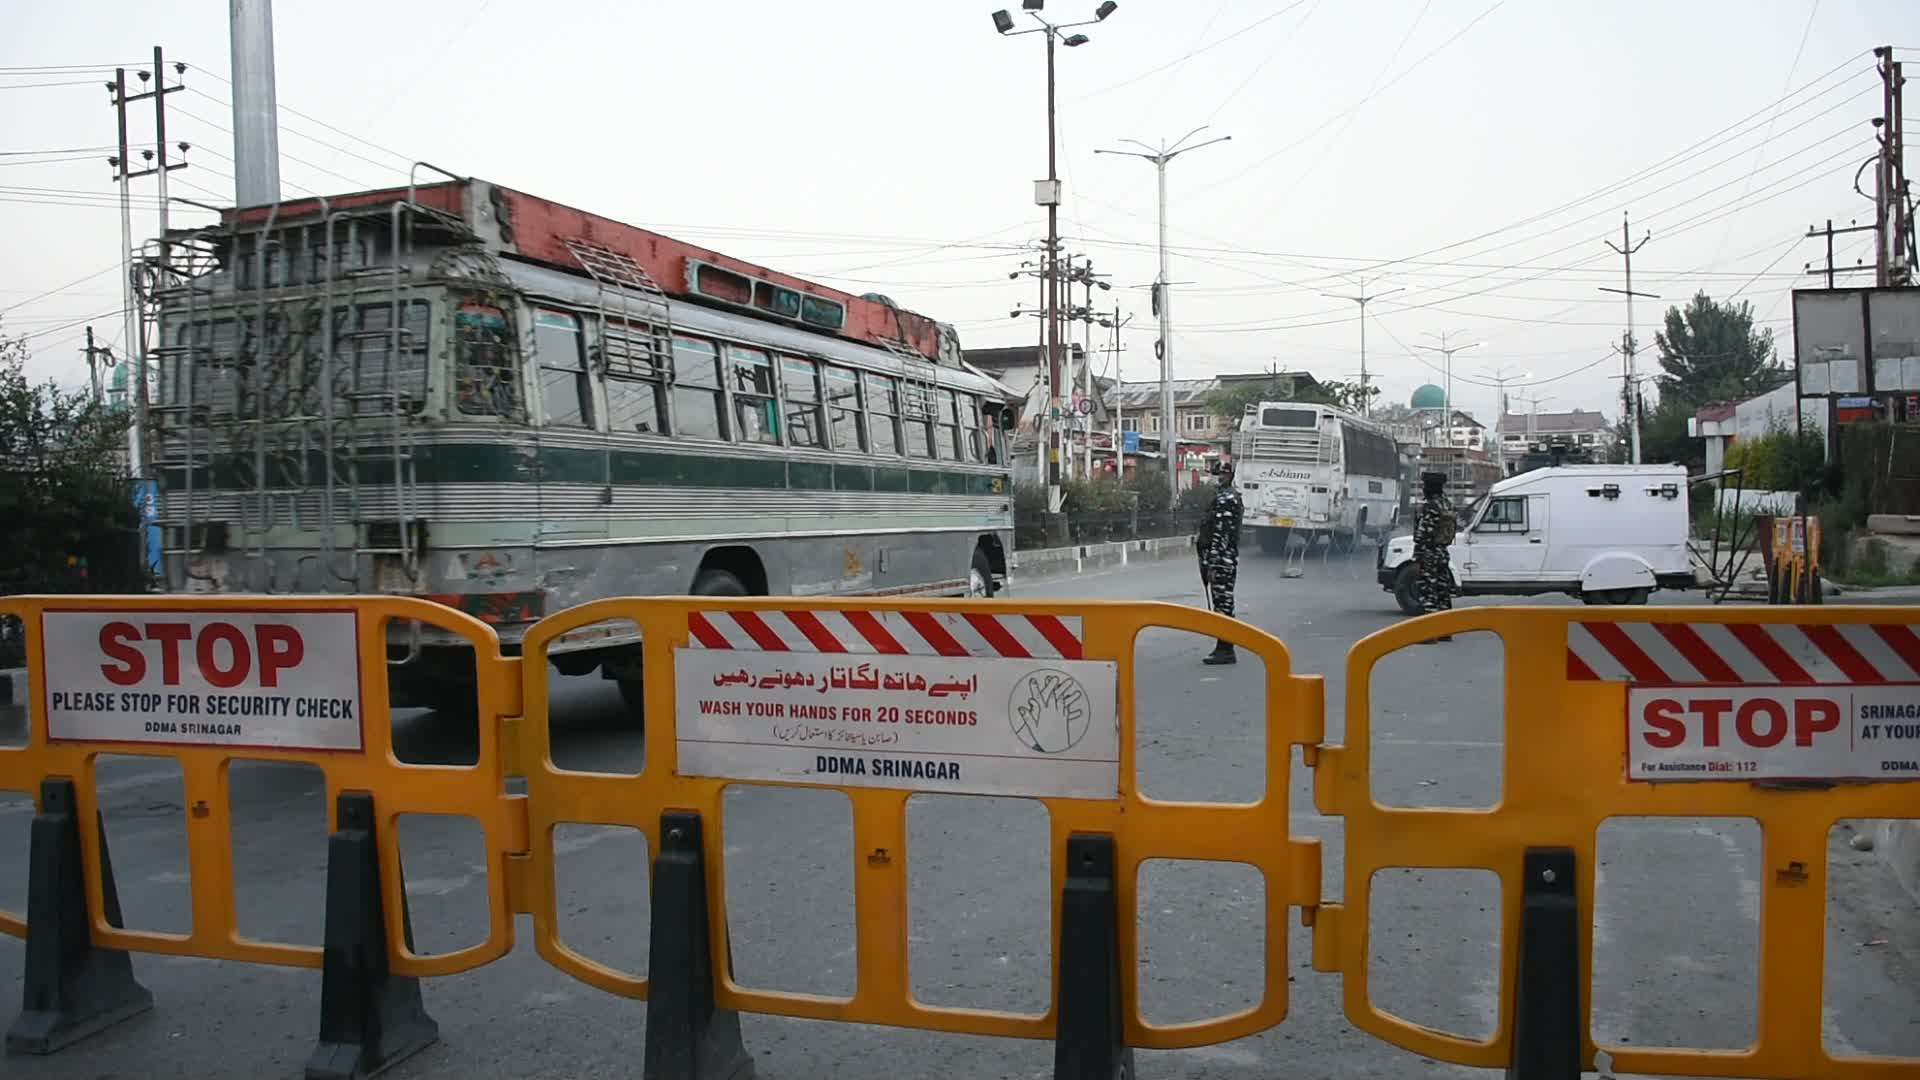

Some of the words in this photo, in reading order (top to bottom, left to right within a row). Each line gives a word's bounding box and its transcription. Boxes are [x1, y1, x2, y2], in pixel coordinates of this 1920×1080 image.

[100, 622, 304, 688] STOP
[52, 692, 115, 712] PLEASE
[121, 693, 162, 713] STOP
[167, 695, 200, 715] FOR
[206, 695, 291, 718] SECURITY
[295, 697, 353, 720] CHECK
[699, 701, 742, 716] WASH
[746, 702, 785, 718] YOUR
[789, 704, 838, 721] HANDS
[842, 707, 872, 723] FOR
[877, 706, 900, 723] 20
[905, 708, 978, 726] SECONDS
[144, 720, 178, 734] DDMA
[180, 722, 242, 736] SRINAGAR
[1643, 698, 1841, 748] STOP
[1861, 725, 1881, 739] AT
[816, 755, 867, 776] DDMA
[871, 758, 961, 781] SRINAGAR
[1641, 762, 1656, 772] For
[1658, 761, 1706, 772] Assistance
[1707, 761, 1732, 772] Dial:
[1736, 761, 1758, 772] 112
[1881, 760, 1919, 771] DDMA
